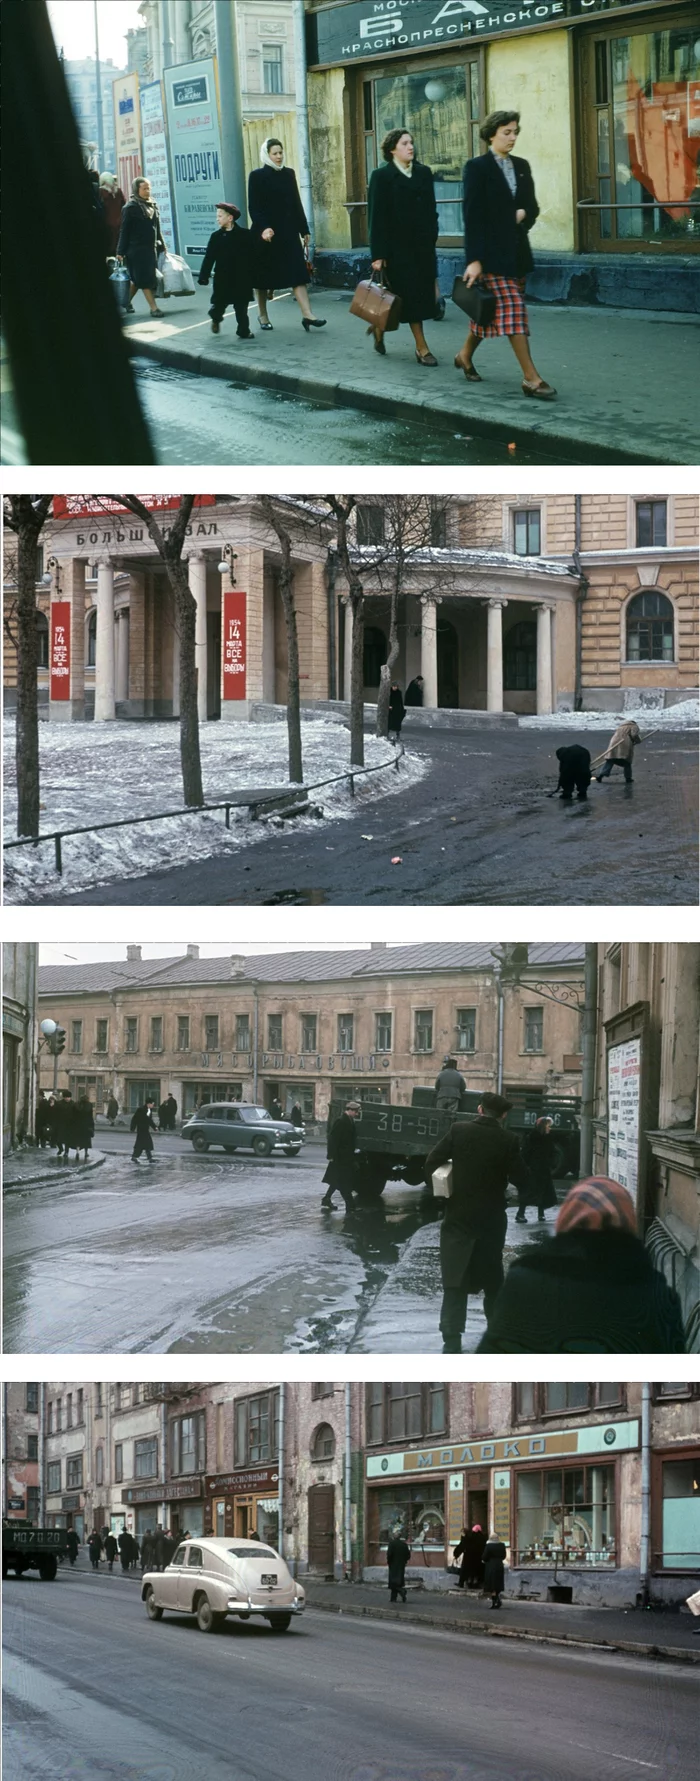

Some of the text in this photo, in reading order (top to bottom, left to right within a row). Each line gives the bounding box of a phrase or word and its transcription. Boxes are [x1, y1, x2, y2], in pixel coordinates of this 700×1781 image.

[373, 0, 421, 12] МОС
[360, 0, 535, 39] БА
[341, 2, 565, 55] КРАСНОПРЕСНЕНСКОЕ
[174, 150, 220, 183] ПОДРУГИ
[184, 522, 217, 537] ЗАЛ
[54, 632, 65, 645] 14
[229, 626, 240, 639] 14
[53, 653, 67, 662] ВСЕ
[226, 649, 242, 658] ВСЕ
[224, 663, 245, 672] ВЫБОРЫ
[201, 1053, 376, 1072] МЯСО РЫБА ОВОЩИ
[416, 1438, 546, 1468] МОЛОКО
